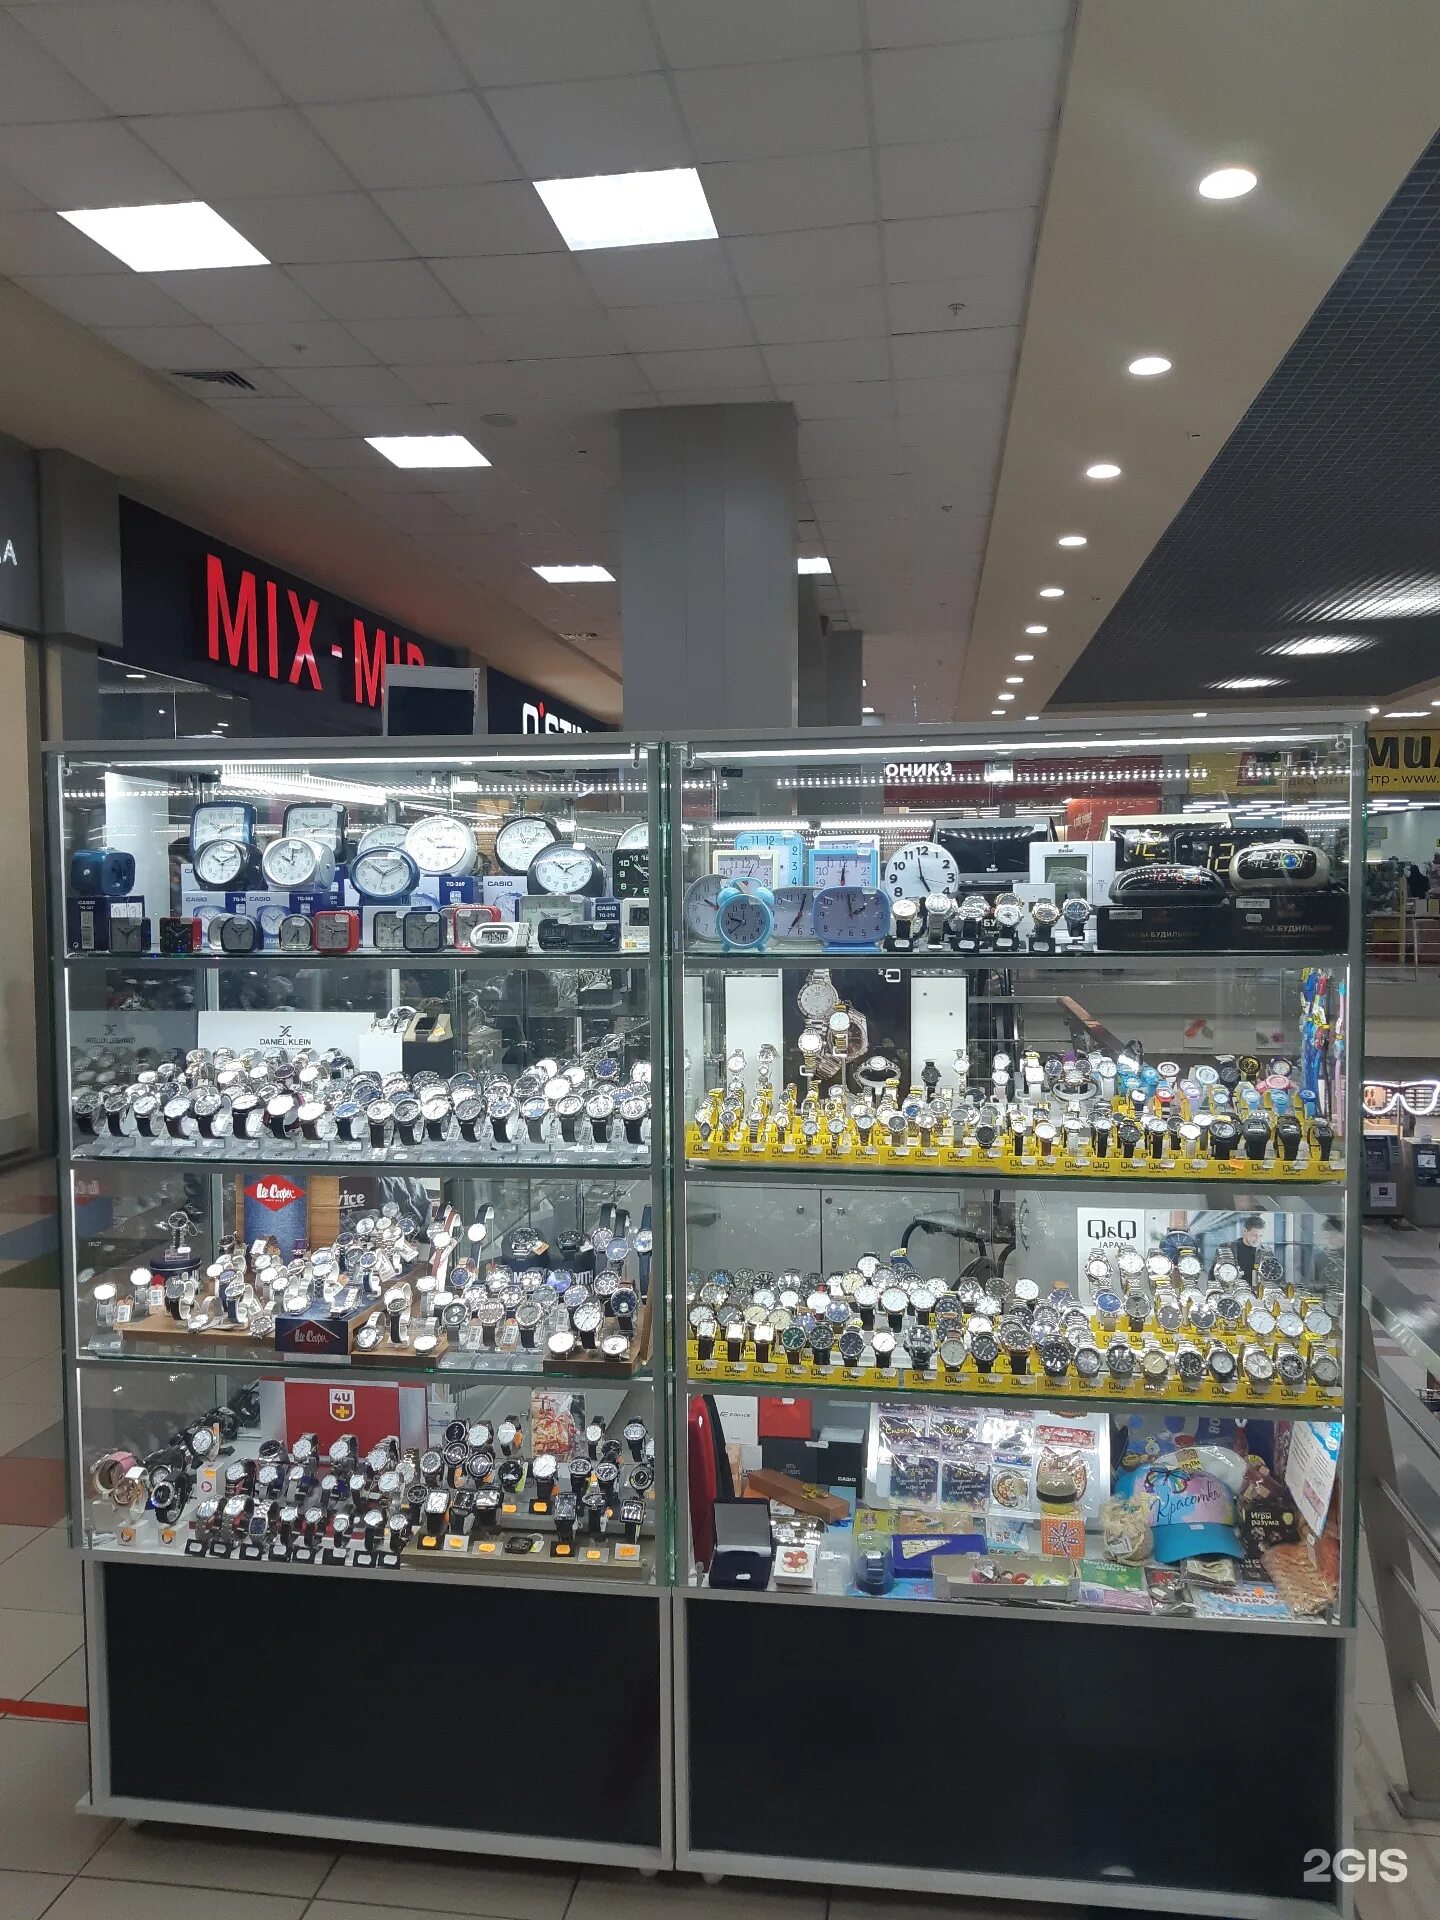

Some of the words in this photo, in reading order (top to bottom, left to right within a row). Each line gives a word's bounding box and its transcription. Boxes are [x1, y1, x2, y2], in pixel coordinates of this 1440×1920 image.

[904, 851, 914, 860] 11
[916, 846, 928, 856] 12
[893, 861, 905, 870] 10
[942, 860, 950, 869] 2
[889, 874, 898, 883] 9
[946, 873, 955, 883] 3
[894, 887, 903, 897] 8
[259, 1038, 287, 1046] DANIEL
[288, 1038, 312, 1046] KLEIN
[1092, 1161, 1110, 1169] Q&Q
[256, 1183, 269, 1198] Lee
[270, 1183, 297, 1202] Cooper
[1087, 1219, 1137, 1241] Q&Q
[1098, 1241, 1127, 1249] JAPAN
[295, 1328, 306, 1343] Lee
[306, 1329, 329, 1346] Cooper
[333, 1391, 351, 1403] 4U
[1149, 1480, 1221, 1525] Красотка
[1250, 1511, 1272, 1520] Игры
[1250, 1519, 1280, 1527] разума
